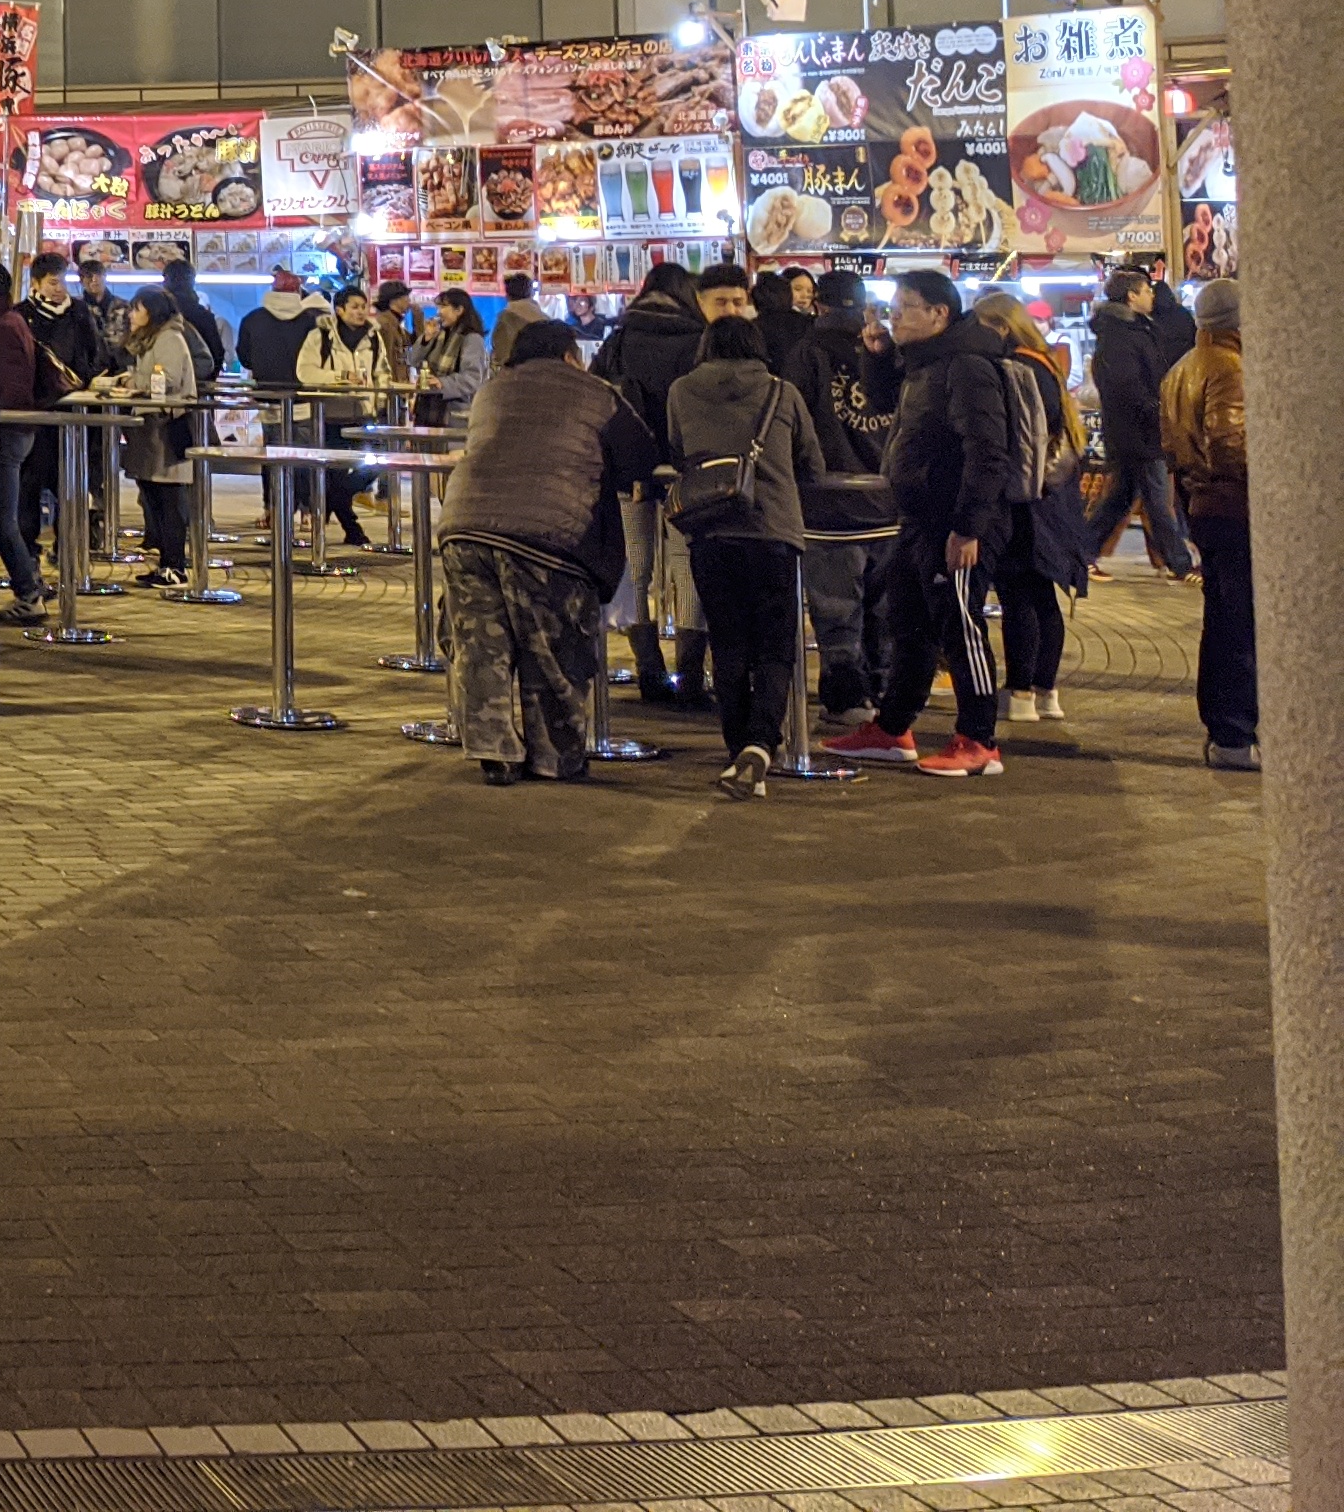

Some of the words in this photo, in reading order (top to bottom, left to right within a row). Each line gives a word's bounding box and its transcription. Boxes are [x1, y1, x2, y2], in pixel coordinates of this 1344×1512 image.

[779, 33, 866, 68] んじゃまん
[1013, 15, 1146, 64] お雑煮
[905, 56, 1006, 112] だんご
[214, 137, 260, 164] 豚汁
[284, 140, 345, 156] MARIO
[802, 163, 866, 196] 豚まん
[143, 202, 222, 221] 豚汁うどん
